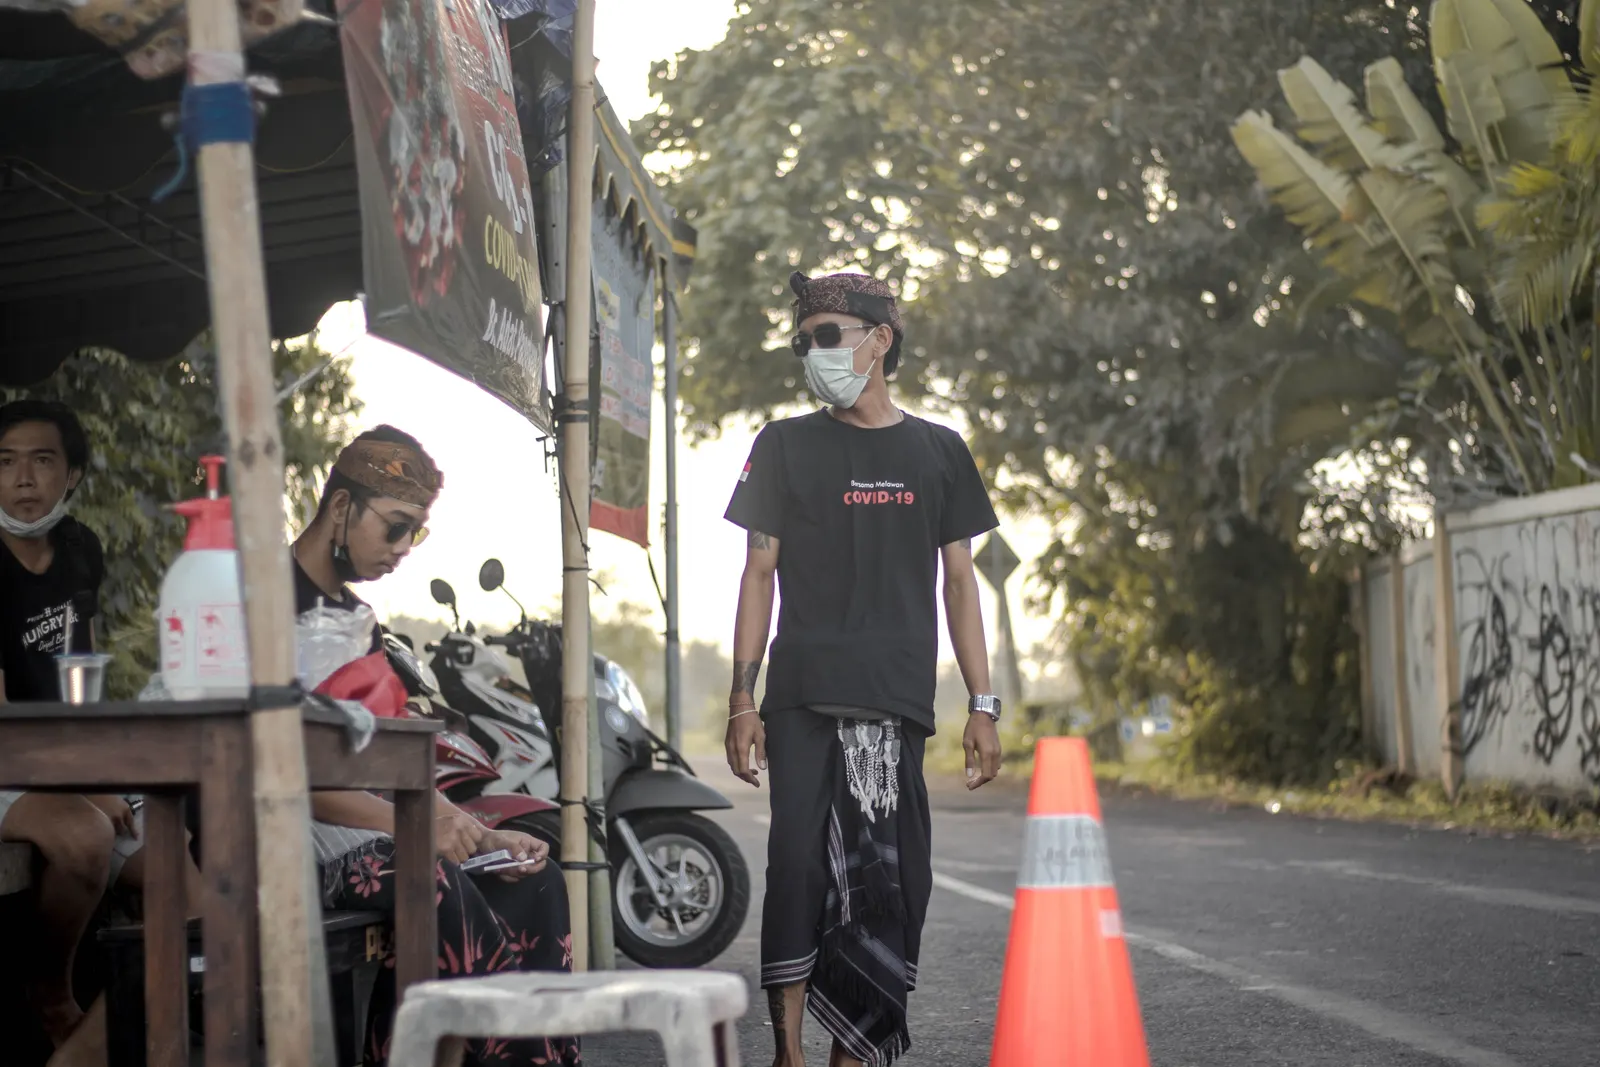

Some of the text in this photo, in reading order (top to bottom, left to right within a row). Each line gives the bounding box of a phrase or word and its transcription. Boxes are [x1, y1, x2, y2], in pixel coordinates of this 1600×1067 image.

[850, 479, 904, 489] Bersama Melawan
[843, 490, 914, 505] COVID-19
